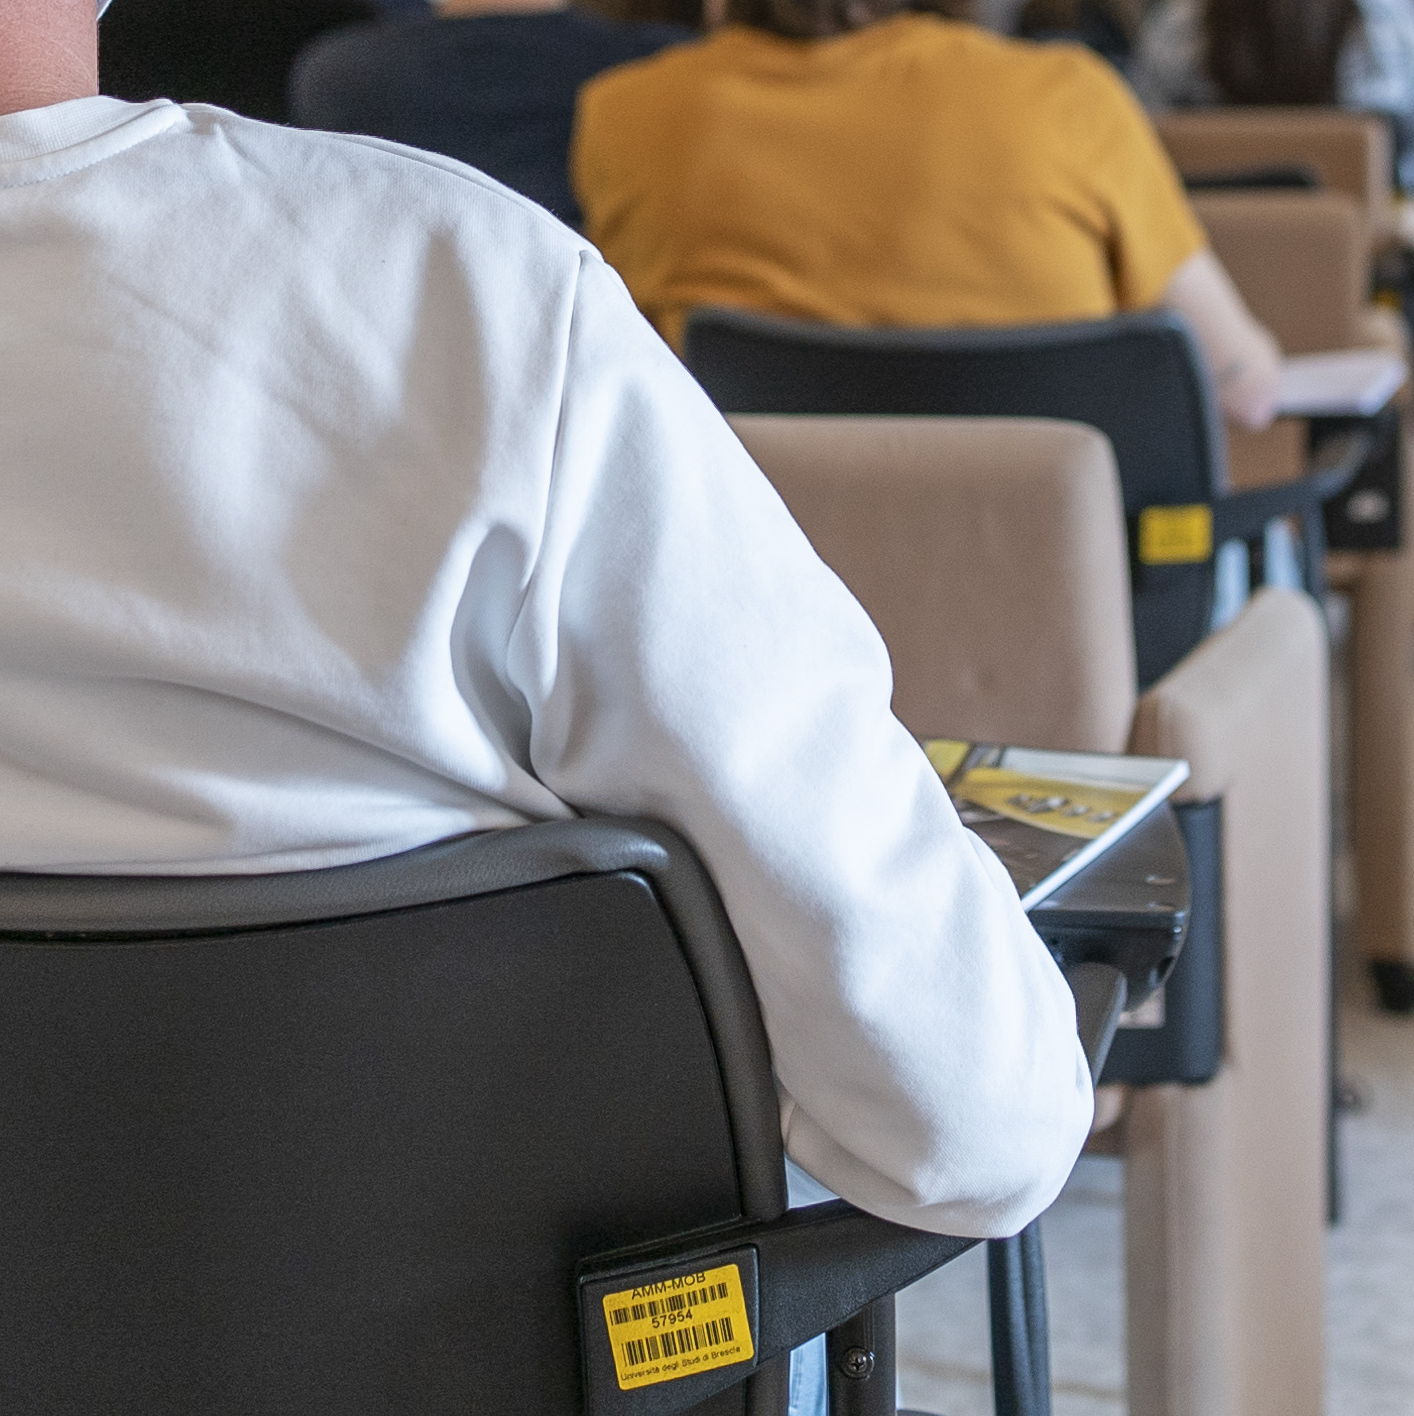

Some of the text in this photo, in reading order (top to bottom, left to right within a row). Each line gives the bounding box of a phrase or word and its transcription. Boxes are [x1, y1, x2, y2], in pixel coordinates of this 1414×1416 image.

[631, 1272, 706, 1300] AMM-MOB
[651, 1309, 693, 1329] 57954
[682, 1356, 701, 1367] Studi
[711, 1346, 741, 1360] Brescia
